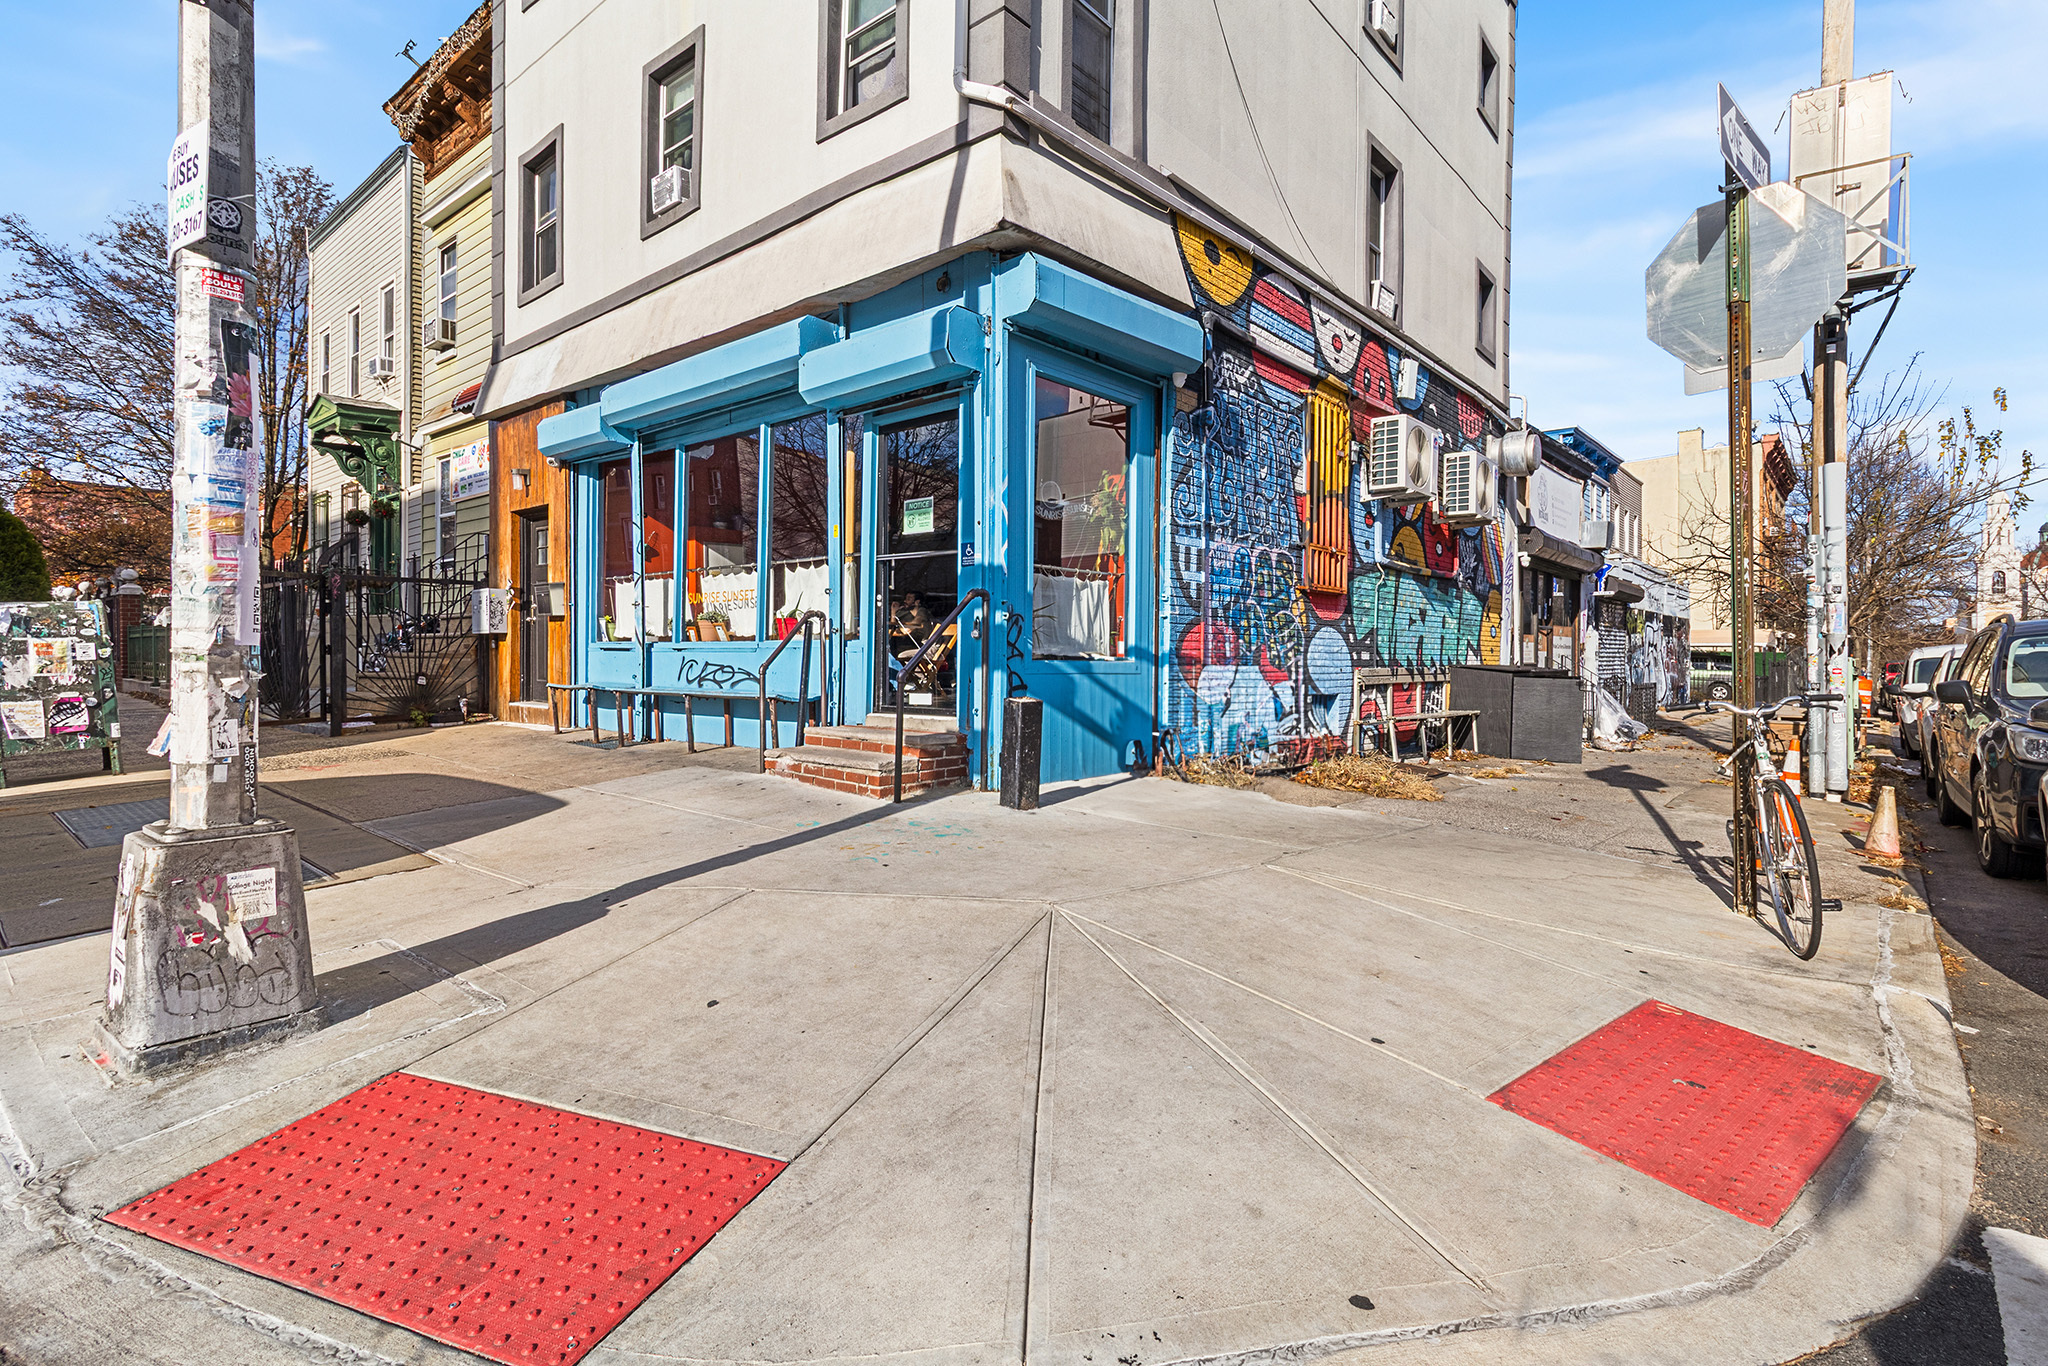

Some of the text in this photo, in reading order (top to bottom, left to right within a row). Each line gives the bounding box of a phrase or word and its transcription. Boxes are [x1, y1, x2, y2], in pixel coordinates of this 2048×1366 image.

[177, 140, 189, 159] BUY
[1728, 116, 1767, 186] ONE WAY
[170, 153, 199, 190] USES
[176, 190, 195, 213] CASH
[204, 269, 244, 284] WE BUY
[909, 501, 930, 510] NOTICE
[688, 588, 755, 605] SUNRISE SUNSET
[252, 878, 274, 888] Night
